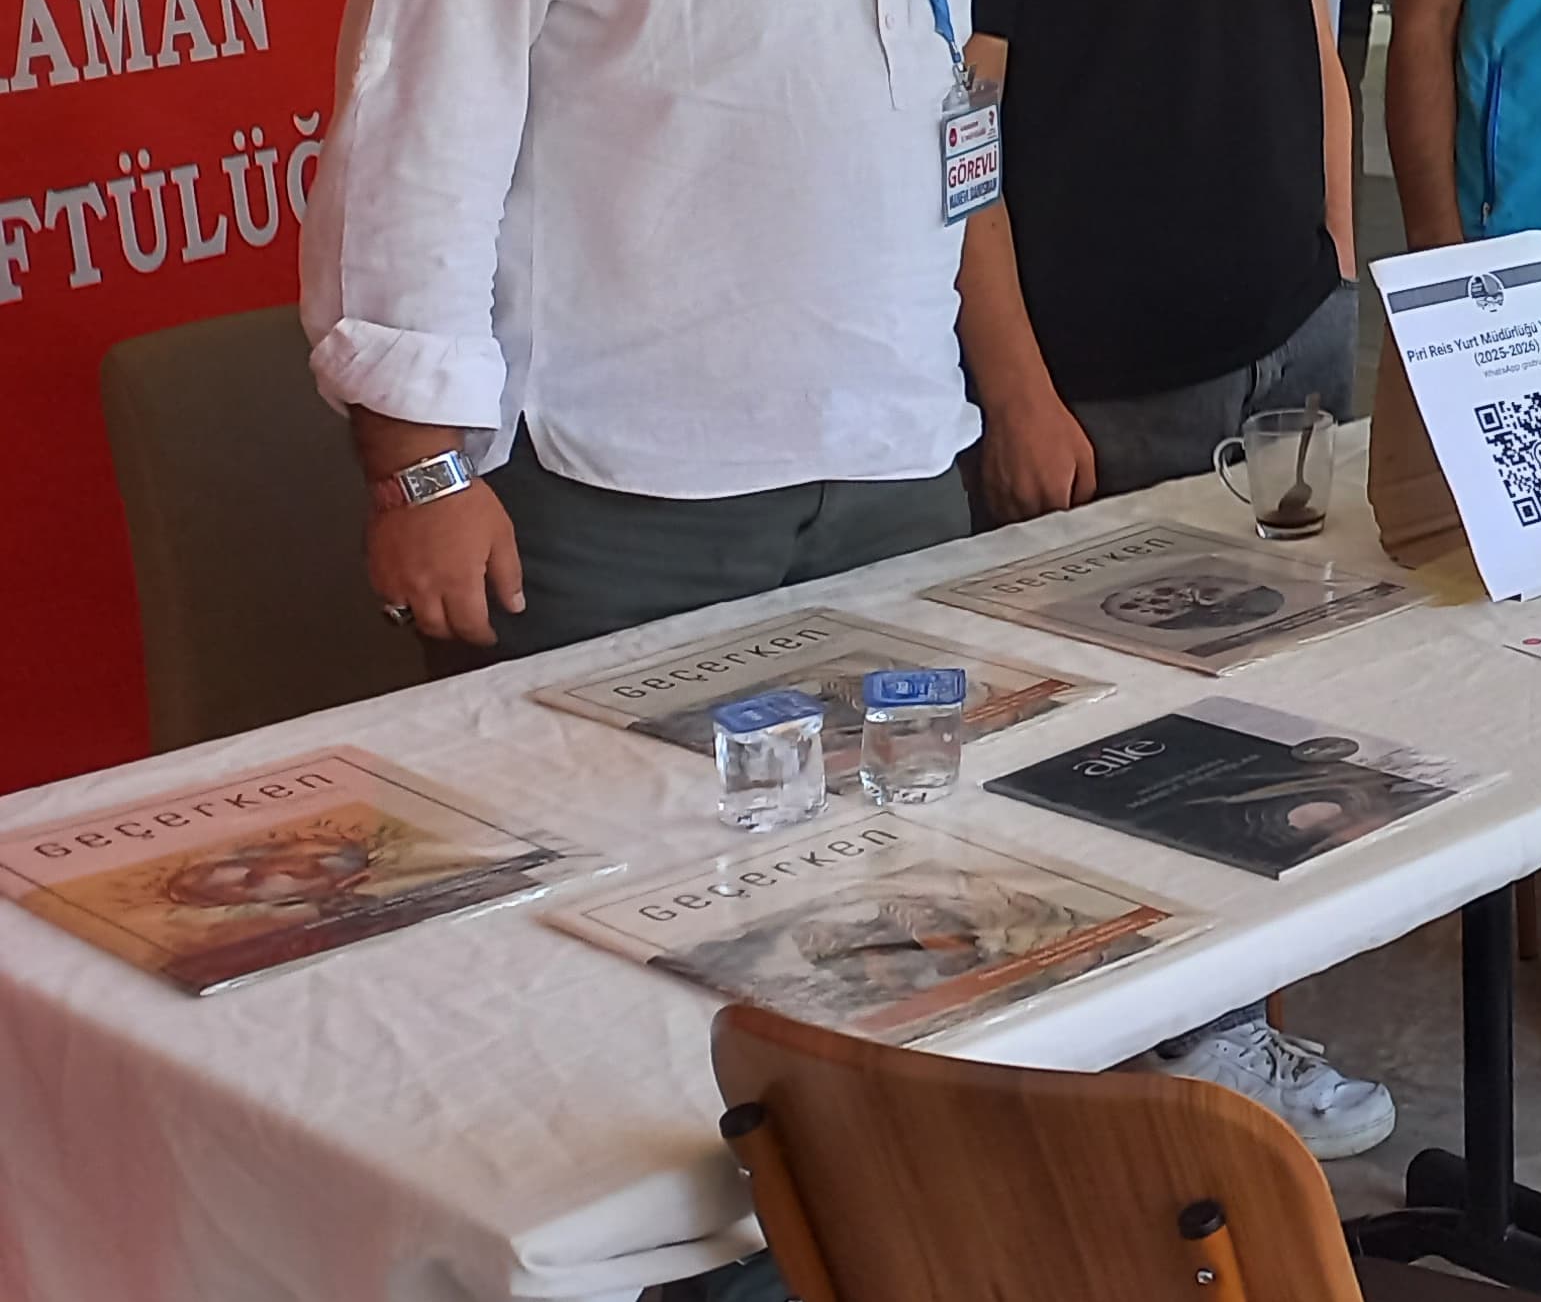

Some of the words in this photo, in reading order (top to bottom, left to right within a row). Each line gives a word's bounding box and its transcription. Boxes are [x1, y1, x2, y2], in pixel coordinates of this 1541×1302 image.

[948, 145, 997, 188] GÖREVLİ
[1429, 341, 1454, 358] Reis
[1454, 336, 1480, 352] Yurt
[1480, 322, 1539, 345] Müdürlüğü
[1474, 338, 1541, 366] (2025-2026)
[34, 770, 335, 860] Geçerken
[638, 828, 898, 923] Geçerken
